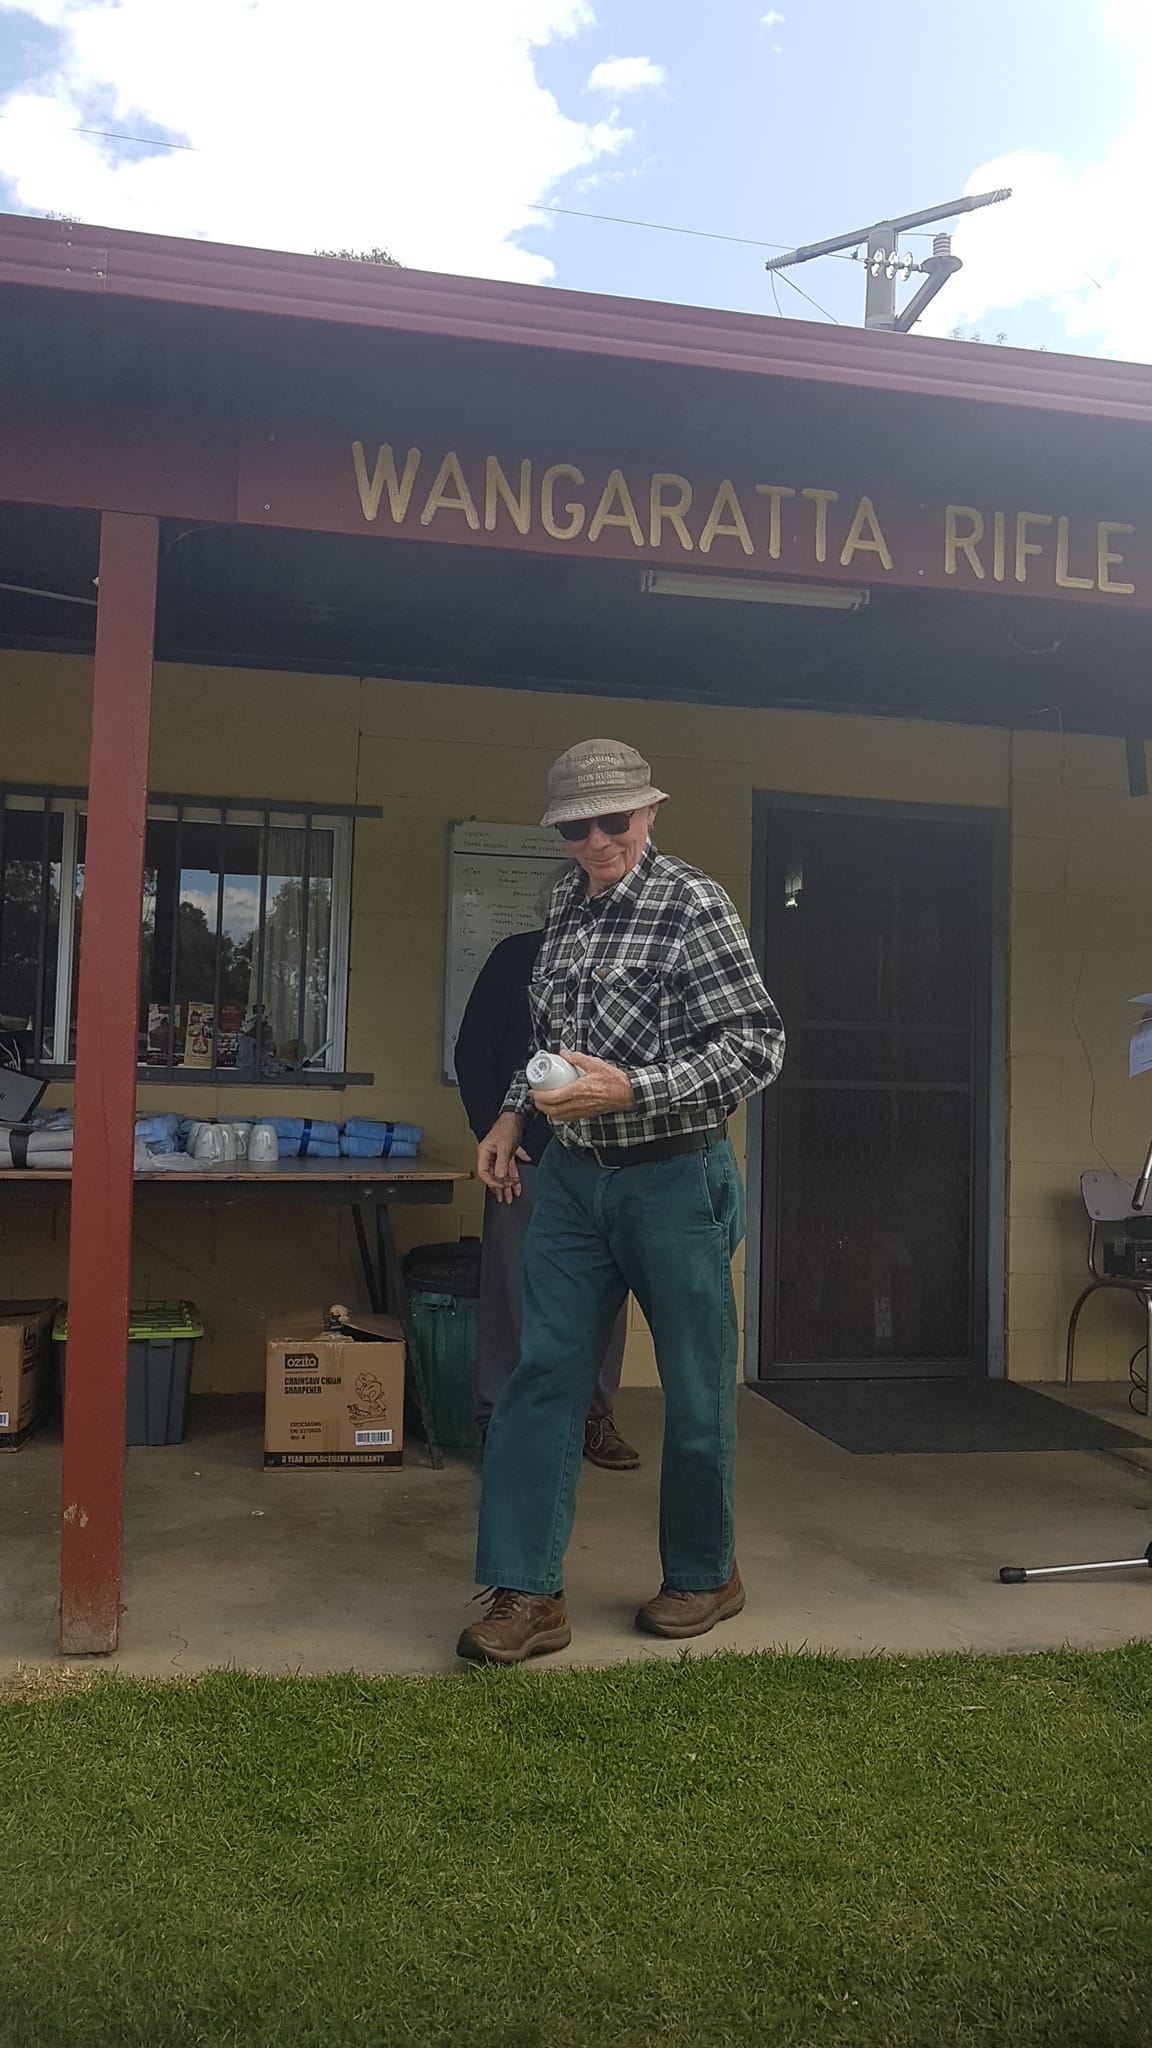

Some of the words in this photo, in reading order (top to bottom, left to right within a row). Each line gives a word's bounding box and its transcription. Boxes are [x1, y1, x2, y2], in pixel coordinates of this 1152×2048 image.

[351, 440, 894, 571] WANGARATTA
[944, 503, 1136, 594] RIFLE
[286, 1356, 317, 1368] ozito
[284, 1377, 320, 1386] CHAINSAW
[284, 1386, 322, 1395] SHARPENER
[288, 1455, 304, 1463] YEAR
[304, 1455, 348, 1463] REPLACEMENT
[350, 1454, 385, 1463] WARRANTY
